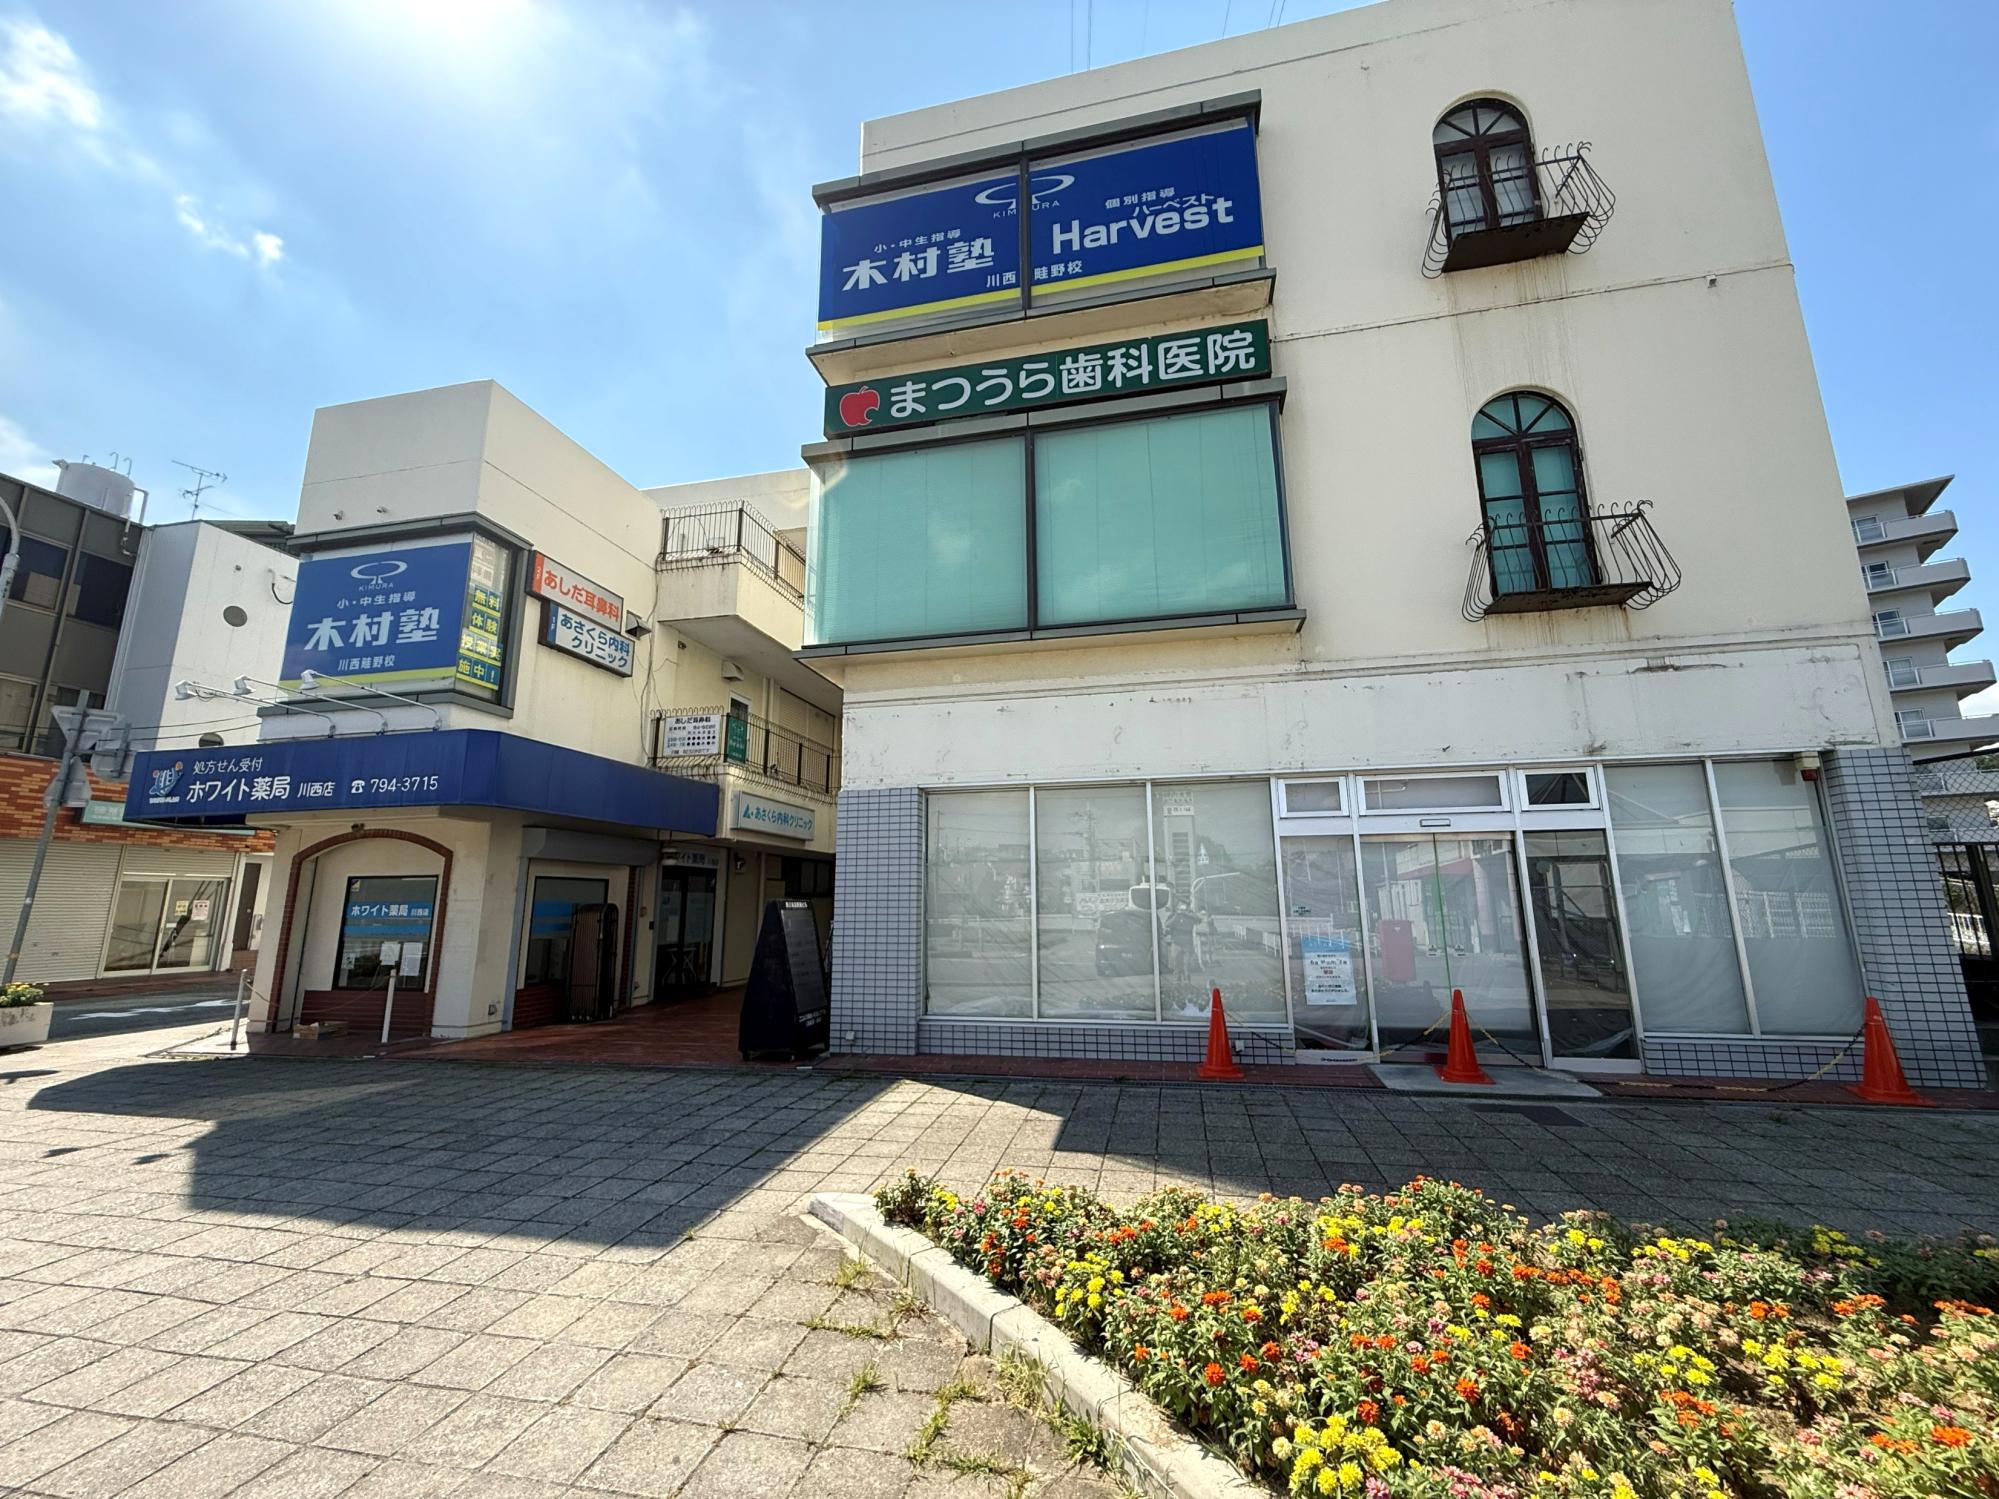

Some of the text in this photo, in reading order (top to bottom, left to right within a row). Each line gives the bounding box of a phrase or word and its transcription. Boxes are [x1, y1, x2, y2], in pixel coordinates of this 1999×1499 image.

[993, 200, 1060, 219] KIMURA
[1105, 187, 1176, 209] 個別指導
[1133, 193, 1215, 217] ハーベスト
[1052, 197, 1234, 255] Harvest
[873, 228, 961, 253] 小・中生指導
[841, 238, 995, 292] 木村塾
[889, 329, 1257, 419] まつうら歯科医院
[337, 591, 416, 609] 小・中生指導
[358, 583, 394, 592] KIMURA
[474, 589, 500, 611] 無料
[543, 569, 620, 622] あしだ耳鼻科
[304, 607, 440, 651] 木村塾
[471, 612, 498, 635] 体験
[560, 613, 630, 656] あさくら内科
[571, 635, 628, 668] クリニック
[192, 757, 264, 775] 処方せん受付
[186, 776, 291, 803] ホワイト薬局
[297, 782, 335, 798] 川西店
[370, 776, 439, 793] 794-3715
[755, 806, 814, 831] あさくら内科クリニック
[351, 904, 409, 917] ホワイト薬局
